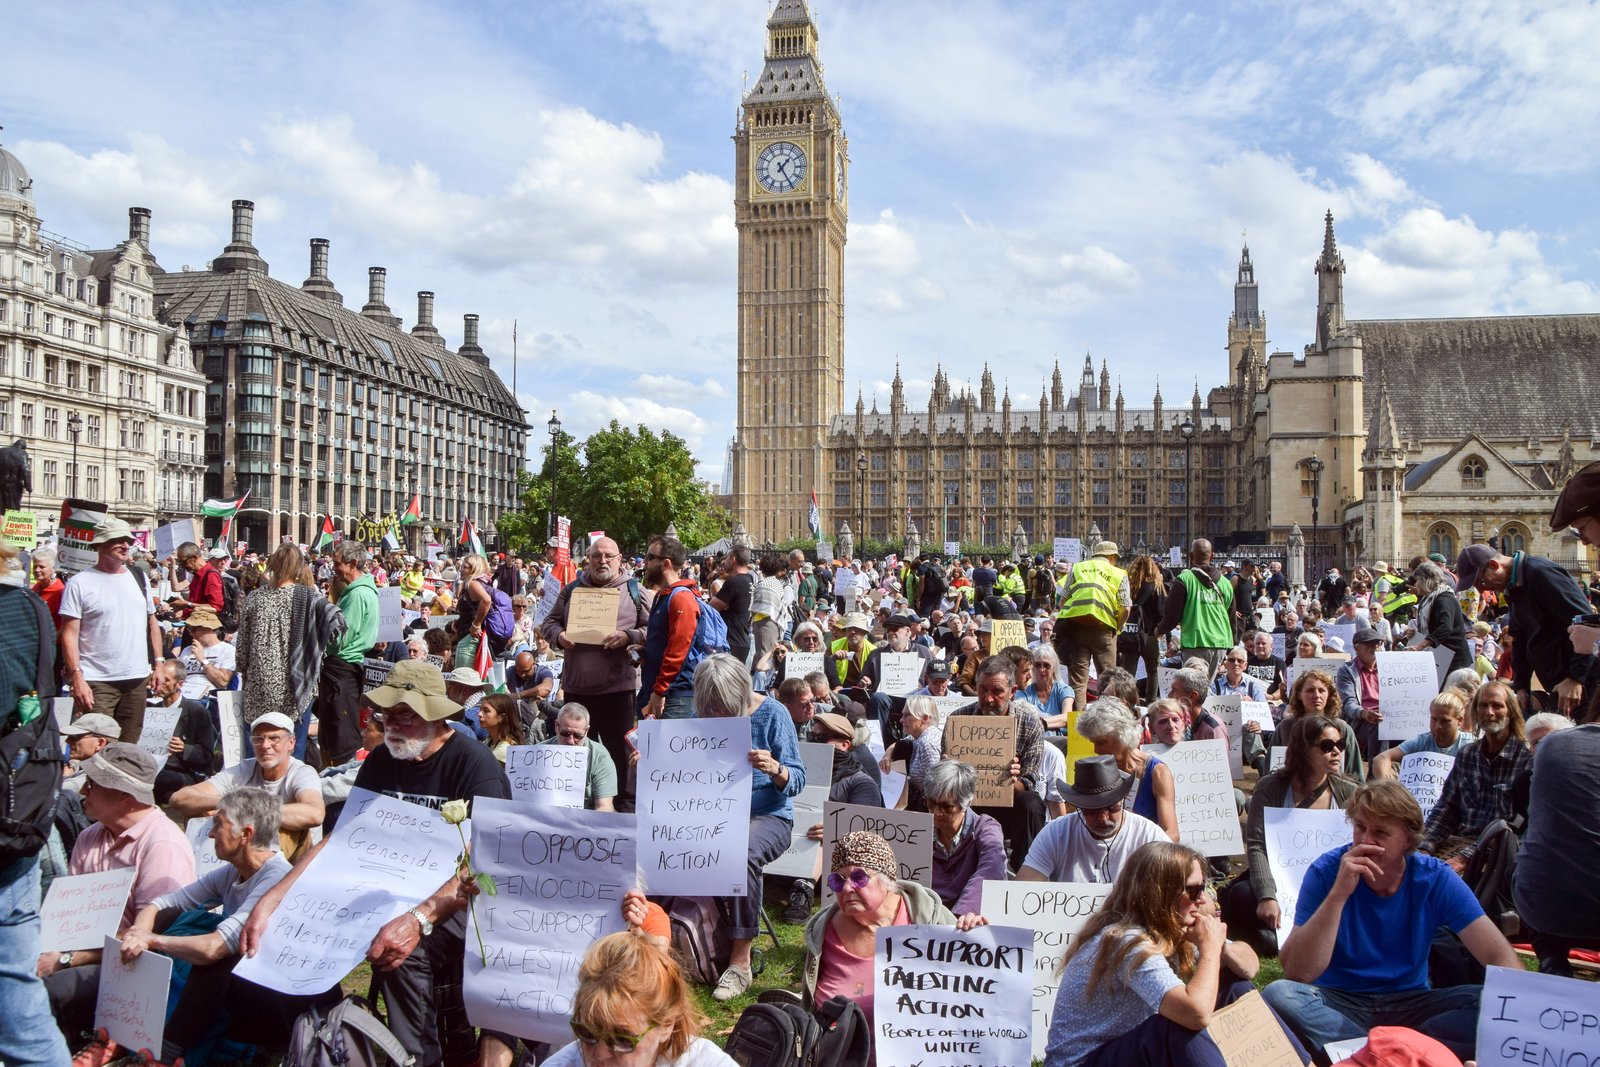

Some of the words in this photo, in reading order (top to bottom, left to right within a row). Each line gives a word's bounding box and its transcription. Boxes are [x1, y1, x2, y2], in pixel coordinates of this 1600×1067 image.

[64, 525, 96, 542] FREE
[368, 524, 403, 544] PEAE
[380, 616, 399, 624] TION
[1000, 622, 1024, 636] OPPOSE
[366, 668, 387, 682] FREEDO
[1382, 662, 1428, 673] OPPOSE
[1380, 676, 1428, 687] GENOCIDE
[951, 721, 956, 742] I
[960, 725, 1011, 742] OPPOSE
[646, 732, 651, 760] I
[669, 735, 730, 753] OPPOSE
[950, 745, 1004, 758] GENOCIDE
[510, 750, 516, 774] I
[523, 751, 584, 768] OPPOSE
[1172, 750, 1224, 764] OPPOSE
[1408, 758, 1452, 771] OPPOSE
[514, 777, 573, 792] GENOCIDE
[650, 769, 738, 792] GENOCIDE
[1172, 772, 1225, 784] OCIDE
[1400, 773, 1446, 786] GENOCID
[976, 790, 1001, 798] TION
[355, 798, 374, 818] I
[376, 808, 434, 834] oppose
[650, 800, 654, 814] I
[668, 798, 738, 812] SUPPORT
[1178, 808, 1234, 824] ESTINE
[652, 821, 728, 843] PALESTINE
[830, 808, 846, 844] I
[850, 814, 926, 845] OPPOSE
[1180, 829, 1234, 842] CTION
[348, 827, 439, 871] Genocide
[494, 824, 512, 864] I
[522, 830, 631, 866] OPPOSE
[658, 850, 720, 870] ACTION
[1278, 854, 1315, 868] GENOC
[286, 894, 382, 921] Support
[1004, 890, 1008, 914] I
[1022, 891, 1104, 917] OPPOSE
[486, 907, 496, 932] I
[506, 908, 608, 940] SUPPORT
[274, 918, 359, 950] Palestine
[276, 946, 336, 970] Action
[885, 937, 892, 962] I
[482, 944, 582, 990] PALESTIN
[496, 988, 572, 1018] ACTIO
[896, 993, 984, 1018] ACTION
[1492, 996, 1518, 1022] I
[1539, 1008, 1600, 1035] OPP
[882, 1023, 936, 1039] PEOPLE
[962, 1028, 986, 1038] THE
[988, 1027, 1028, 1040] WORLD
[924, 1042, 982, 1054] UNITE
[1231, 1036, 1276, 1067] ENOCIDE
